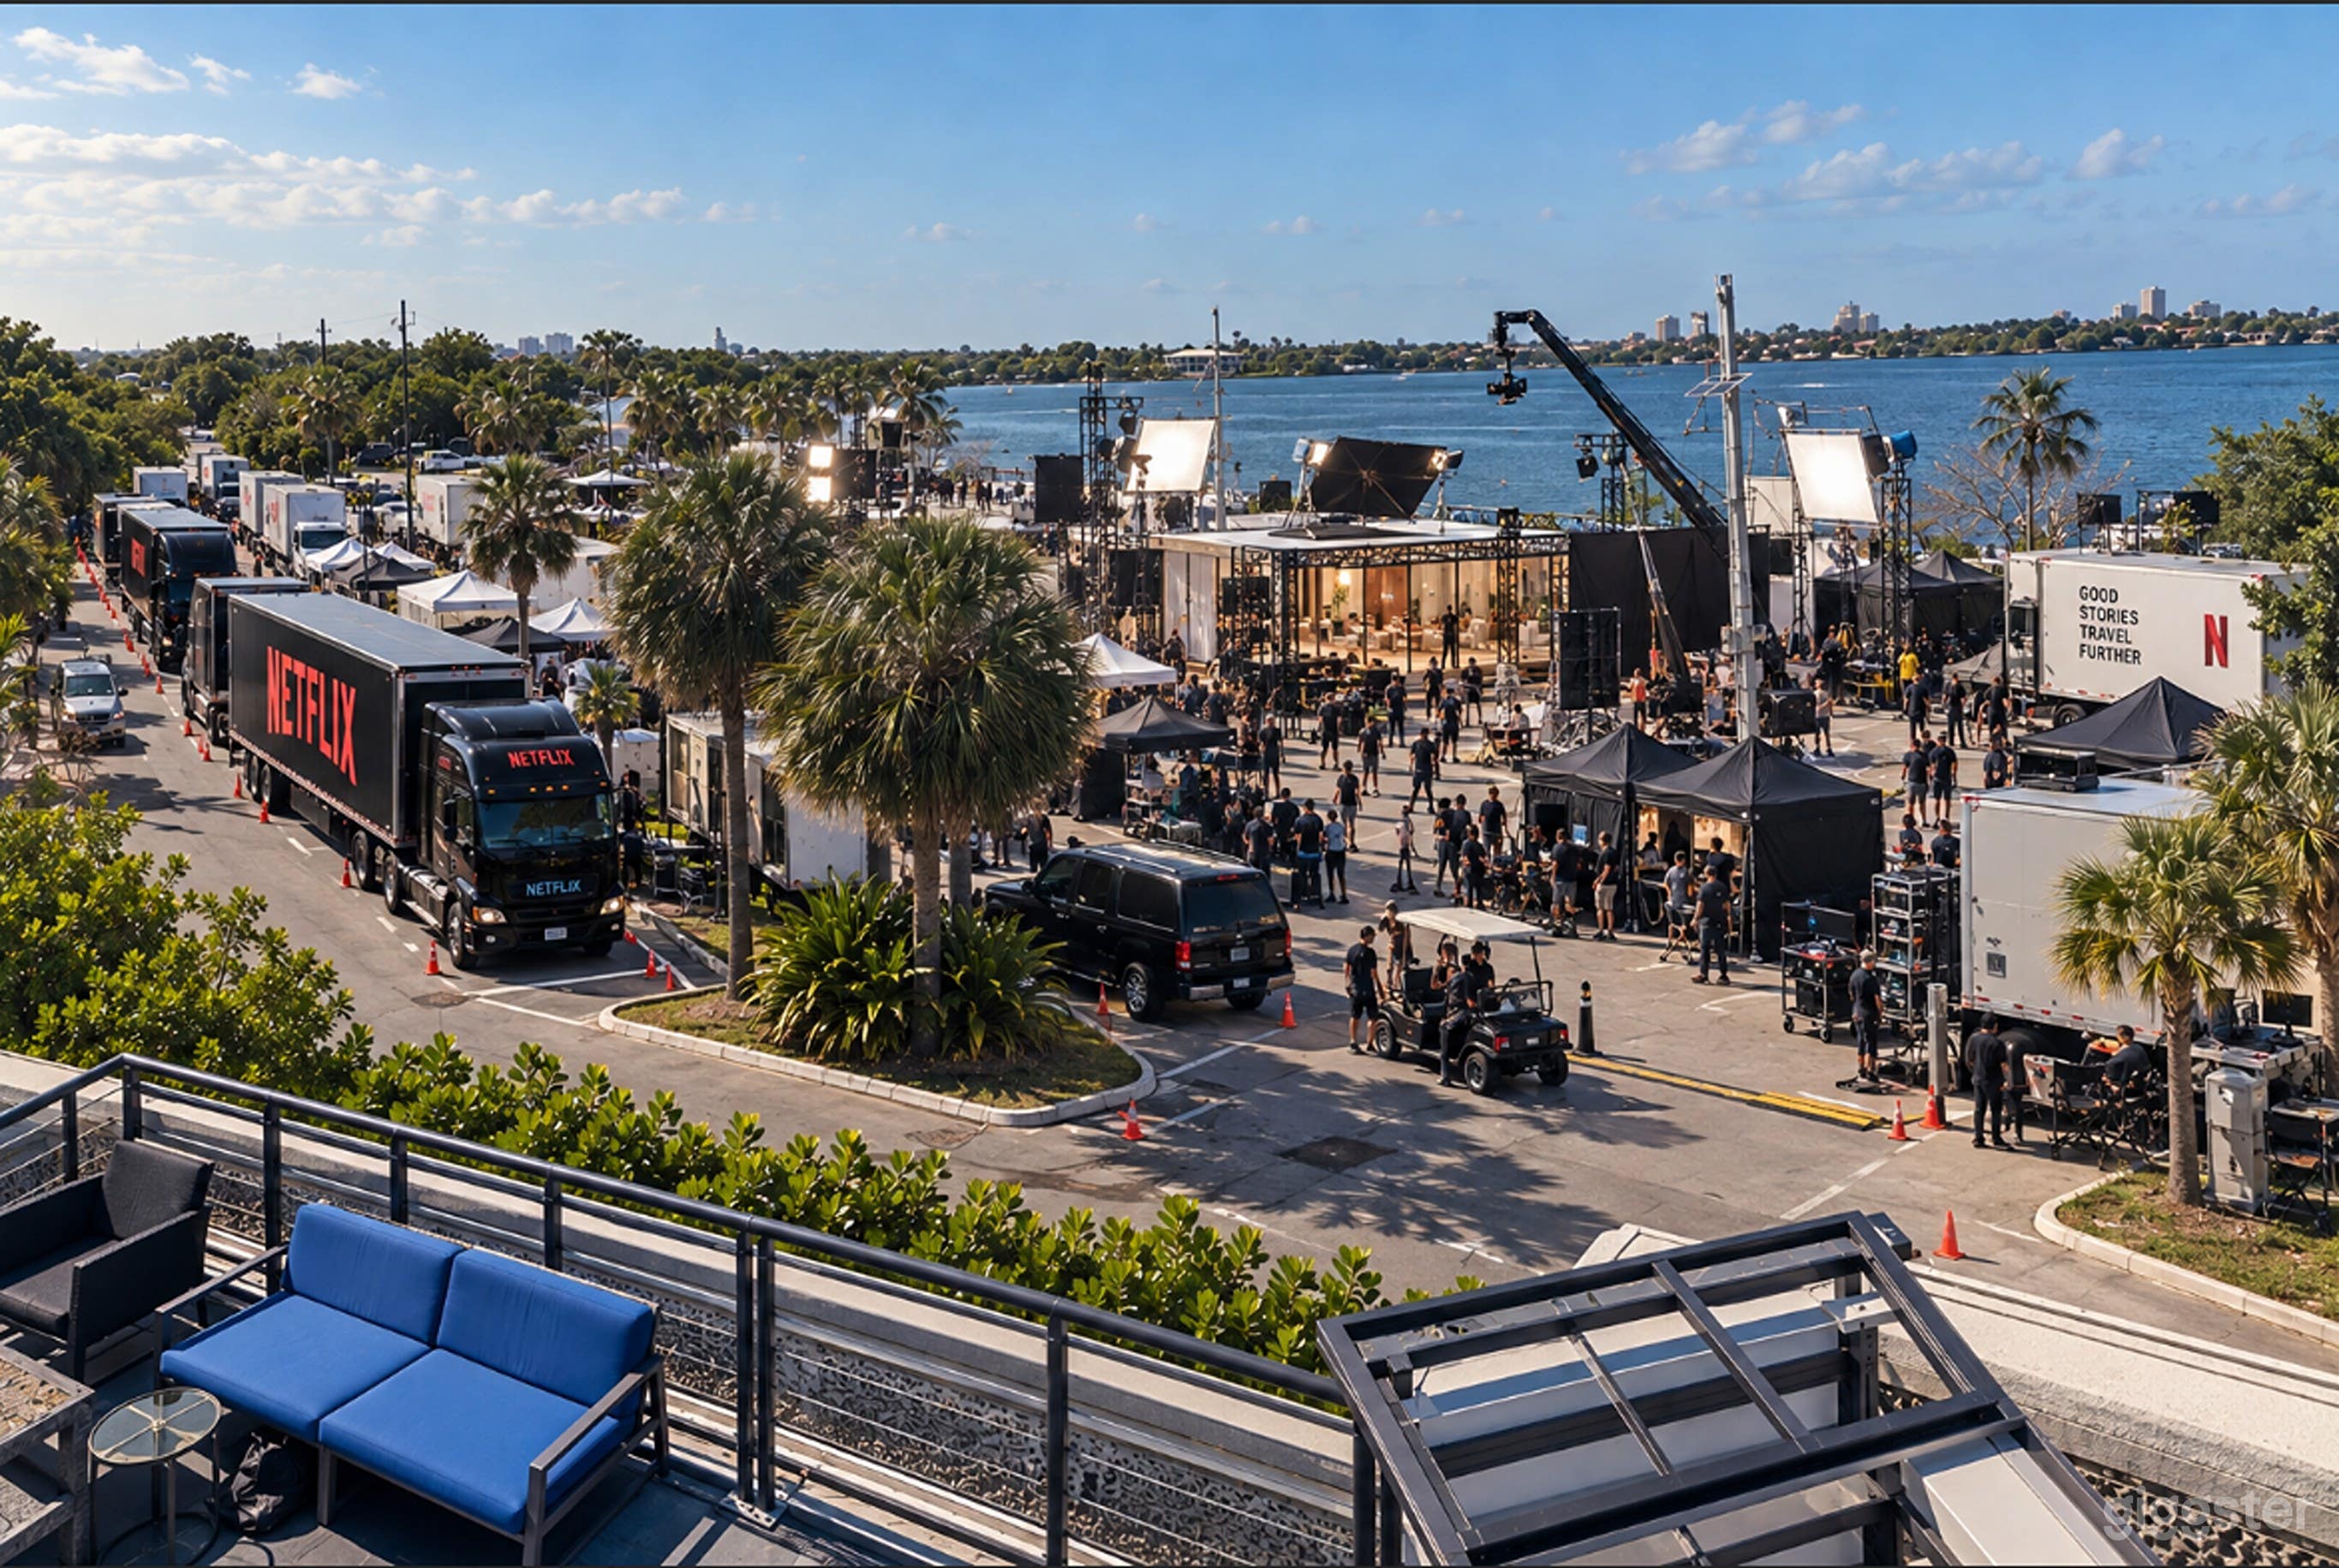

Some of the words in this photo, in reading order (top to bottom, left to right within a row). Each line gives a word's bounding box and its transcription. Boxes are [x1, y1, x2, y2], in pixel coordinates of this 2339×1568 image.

[2079, 586, 2119, 603] GOOD
[2079, 605, 2139, 625] STORIES
[2079, 623, 2133, 644] TRAVEL
[2204, 613, 2229, 668] N
[2079, 643, 2141, 665] FURTHER
[266, 645, 357, 787] NETFLIX
[507, 748, 576, 768] NETFLIX
[525, 879, 582, 897] NETFLIX
